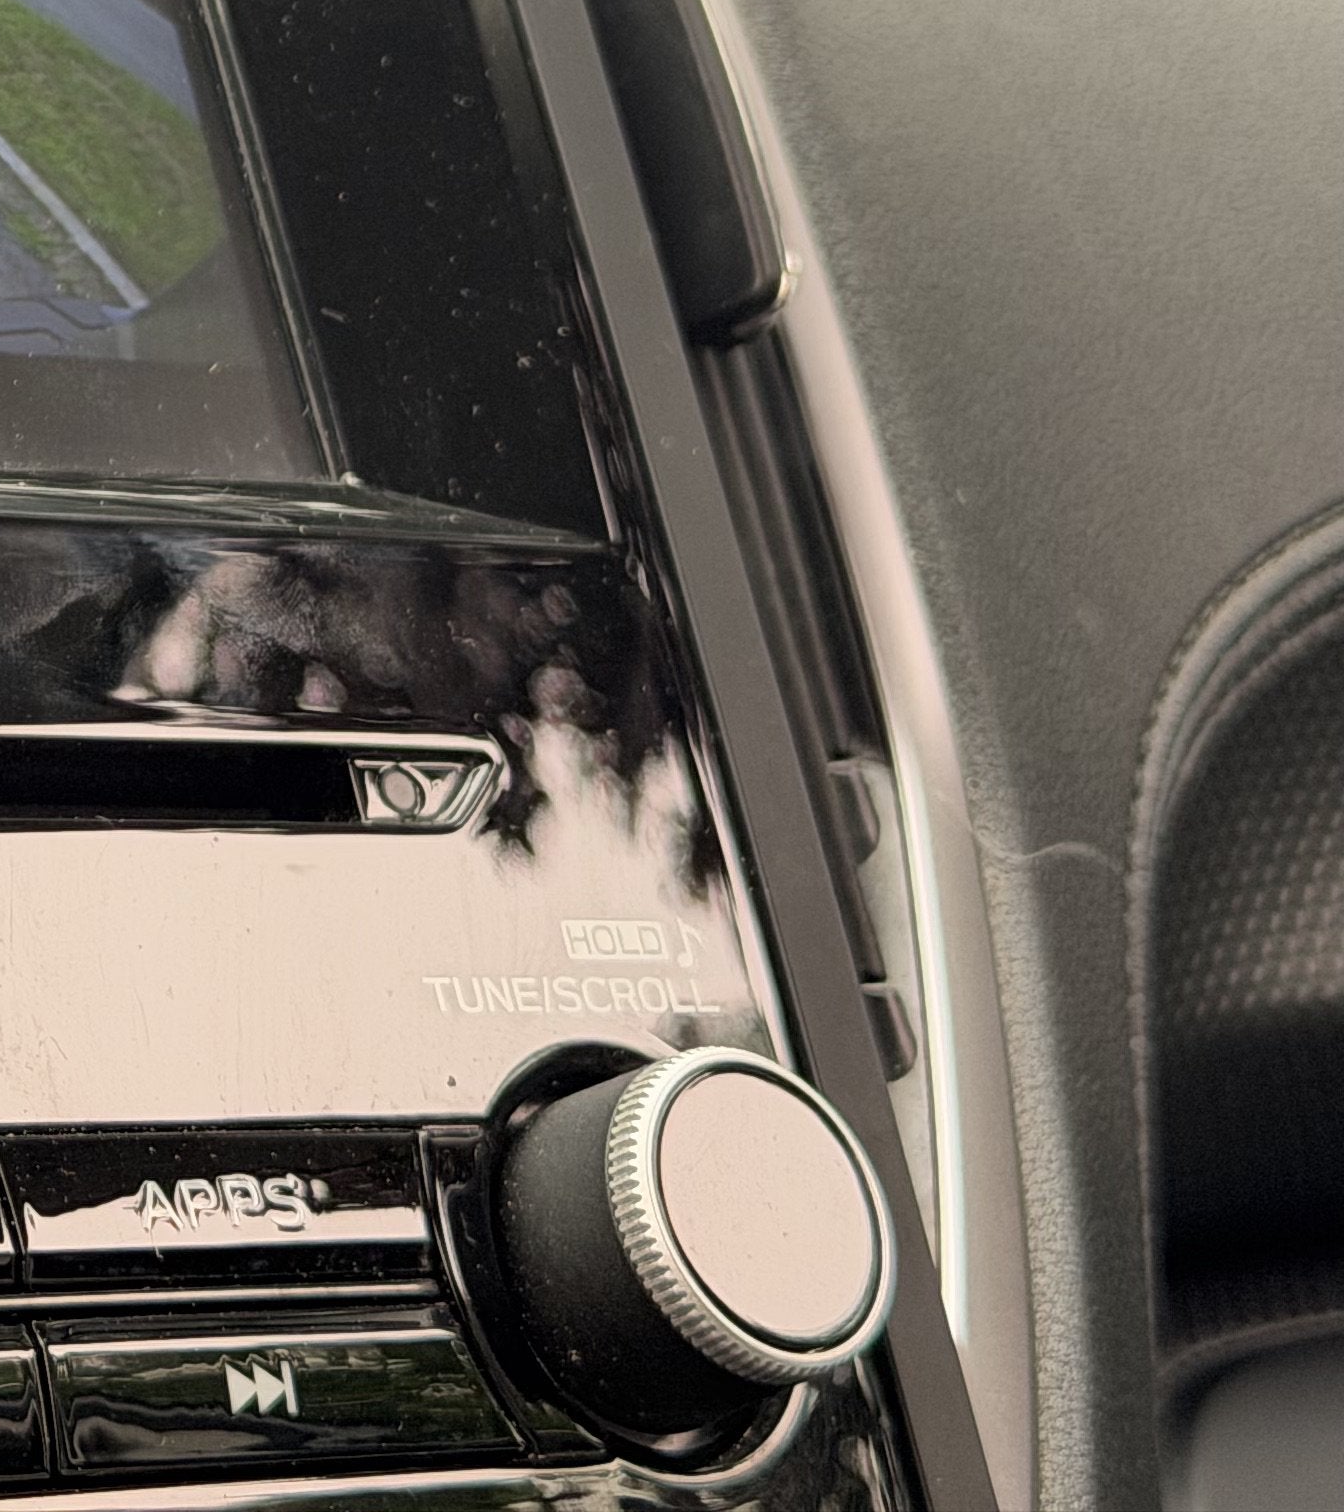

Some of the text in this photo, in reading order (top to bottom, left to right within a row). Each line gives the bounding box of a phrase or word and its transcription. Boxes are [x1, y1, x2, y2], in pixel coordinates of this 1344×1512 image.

[564, 924, 663, 957] HOLD
[421, 975, 721, 1014] TUNE/SCROLL
[140, 1173, 307, 1232] APPS
